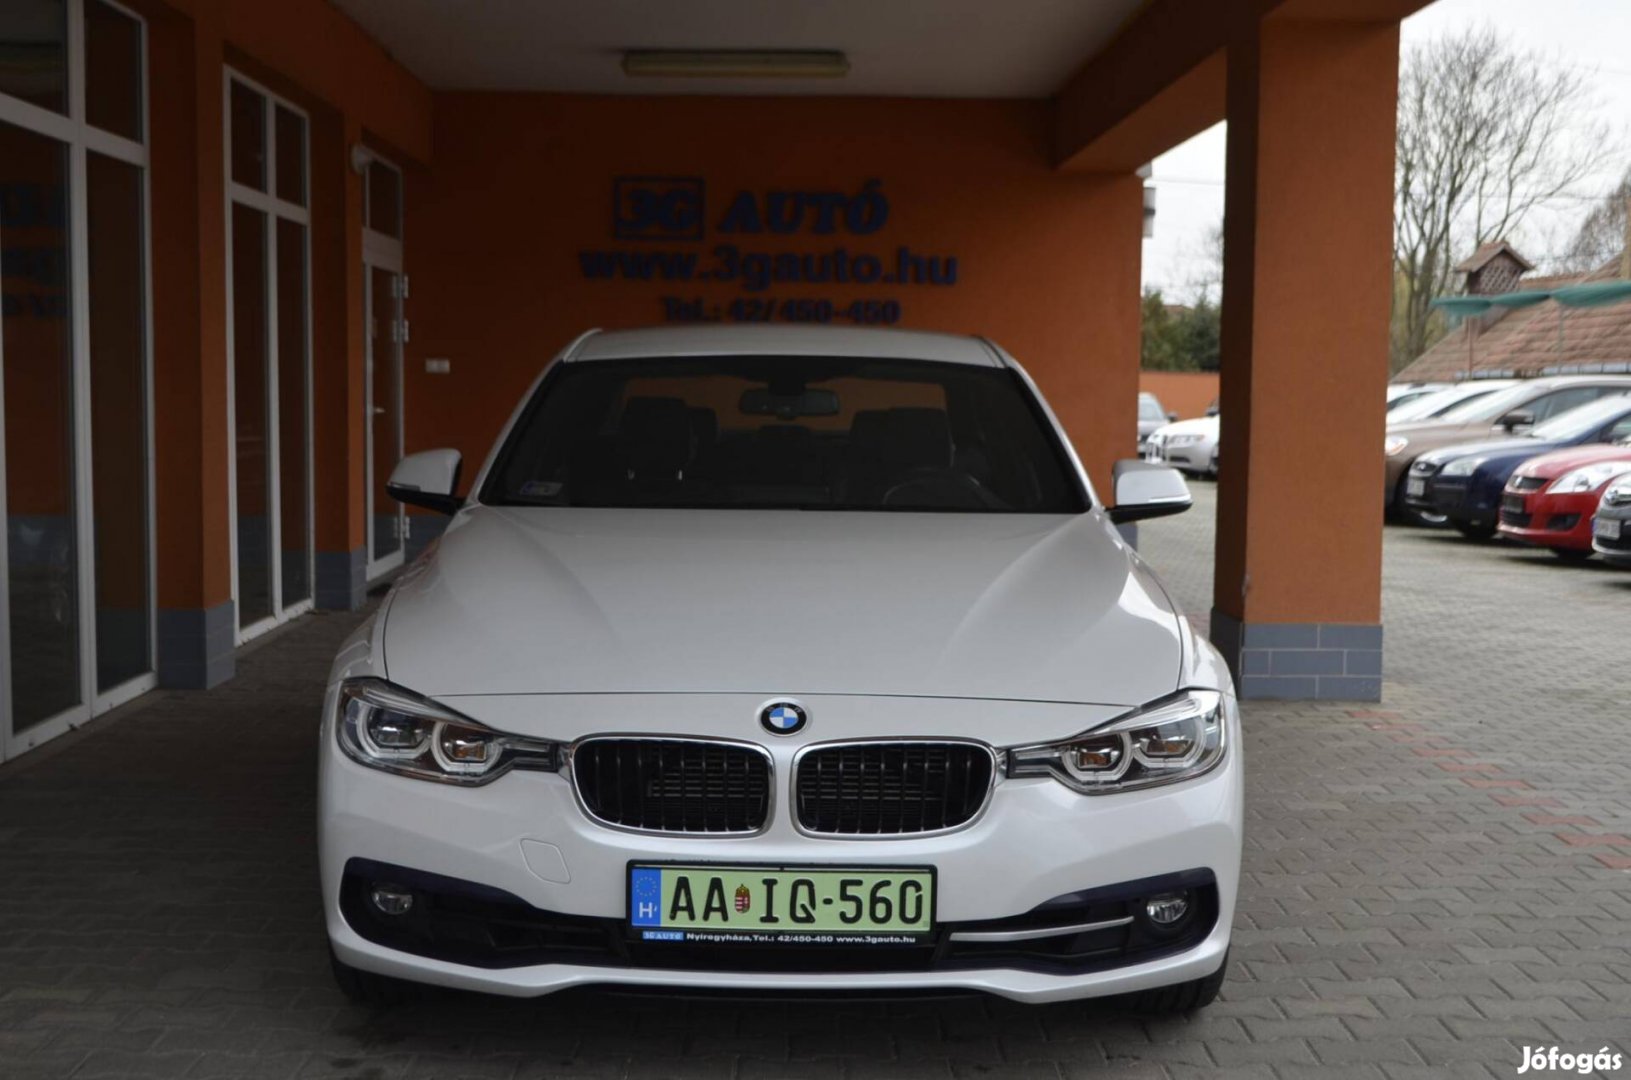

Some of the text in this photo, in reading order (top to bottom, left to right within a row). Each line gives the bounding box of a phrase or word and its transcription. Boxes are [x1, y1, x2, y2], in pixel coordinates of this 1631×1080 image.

[617, 178, 891, 235] 3G AUTÓ
[578, 244, 958, 292] www.3gauto.hu
[661, 296, 721, 323] Tel.:
[639, 902, 653, 919] H
[669, 876, 923, 925] AA IQ-560
[777, 935, 834, 943] 42/450-450
[836, 935, 916, 944] www.3gauto.hu
